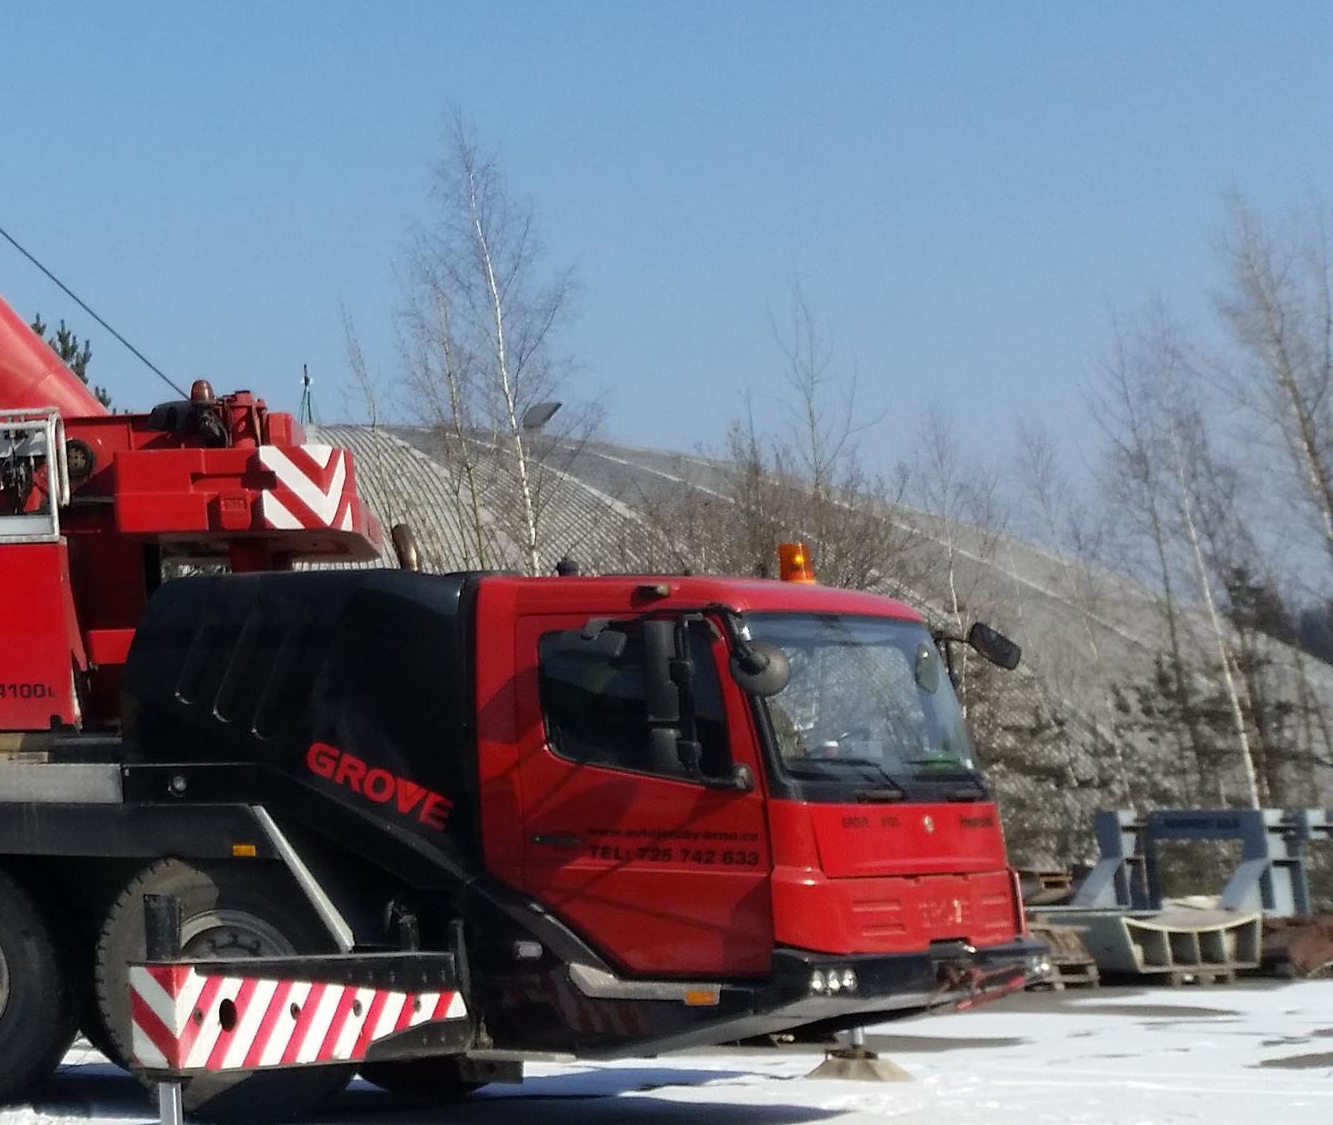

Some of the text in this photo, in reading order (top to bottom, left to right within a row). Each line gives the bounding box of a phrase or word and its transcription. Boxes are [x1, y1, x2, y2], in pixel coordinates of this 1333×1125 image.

[306, 741, 454, 830] GROVE
[588, 845, 760, 866] TEL: 725 742 633
